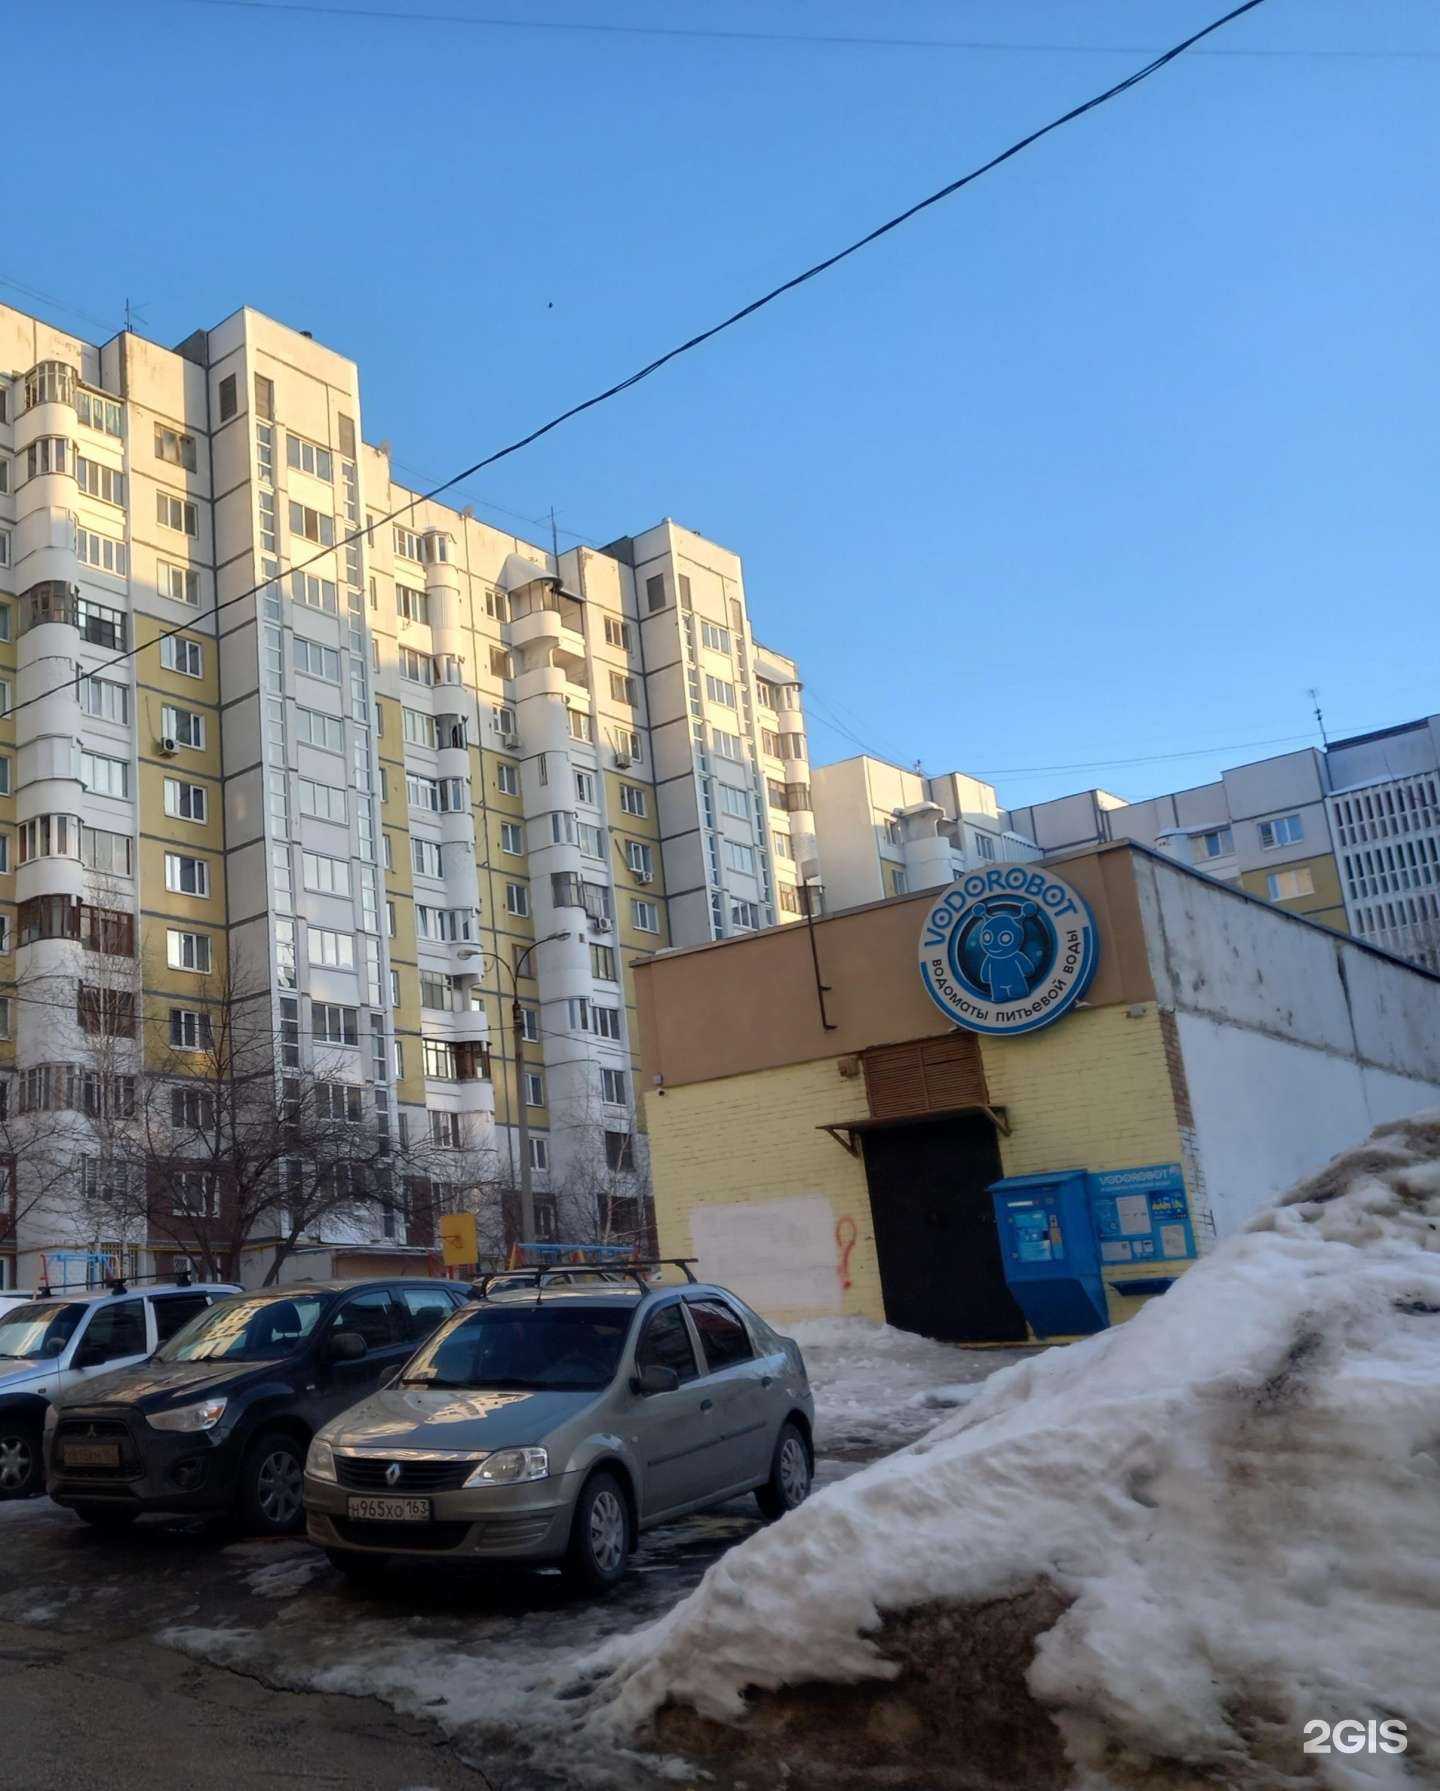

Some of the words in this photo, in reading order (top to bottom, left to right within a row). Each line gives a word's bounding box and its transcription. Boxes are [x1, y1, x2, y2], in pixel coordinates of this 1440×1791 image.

[924, 867, 1078, 947] VODOROBOT
[1063, 929, 1081, 975] ВОДЫ
[351, 1500, 404, 1518] Н965ХО
[406, 1500, 427, 1514] 163
